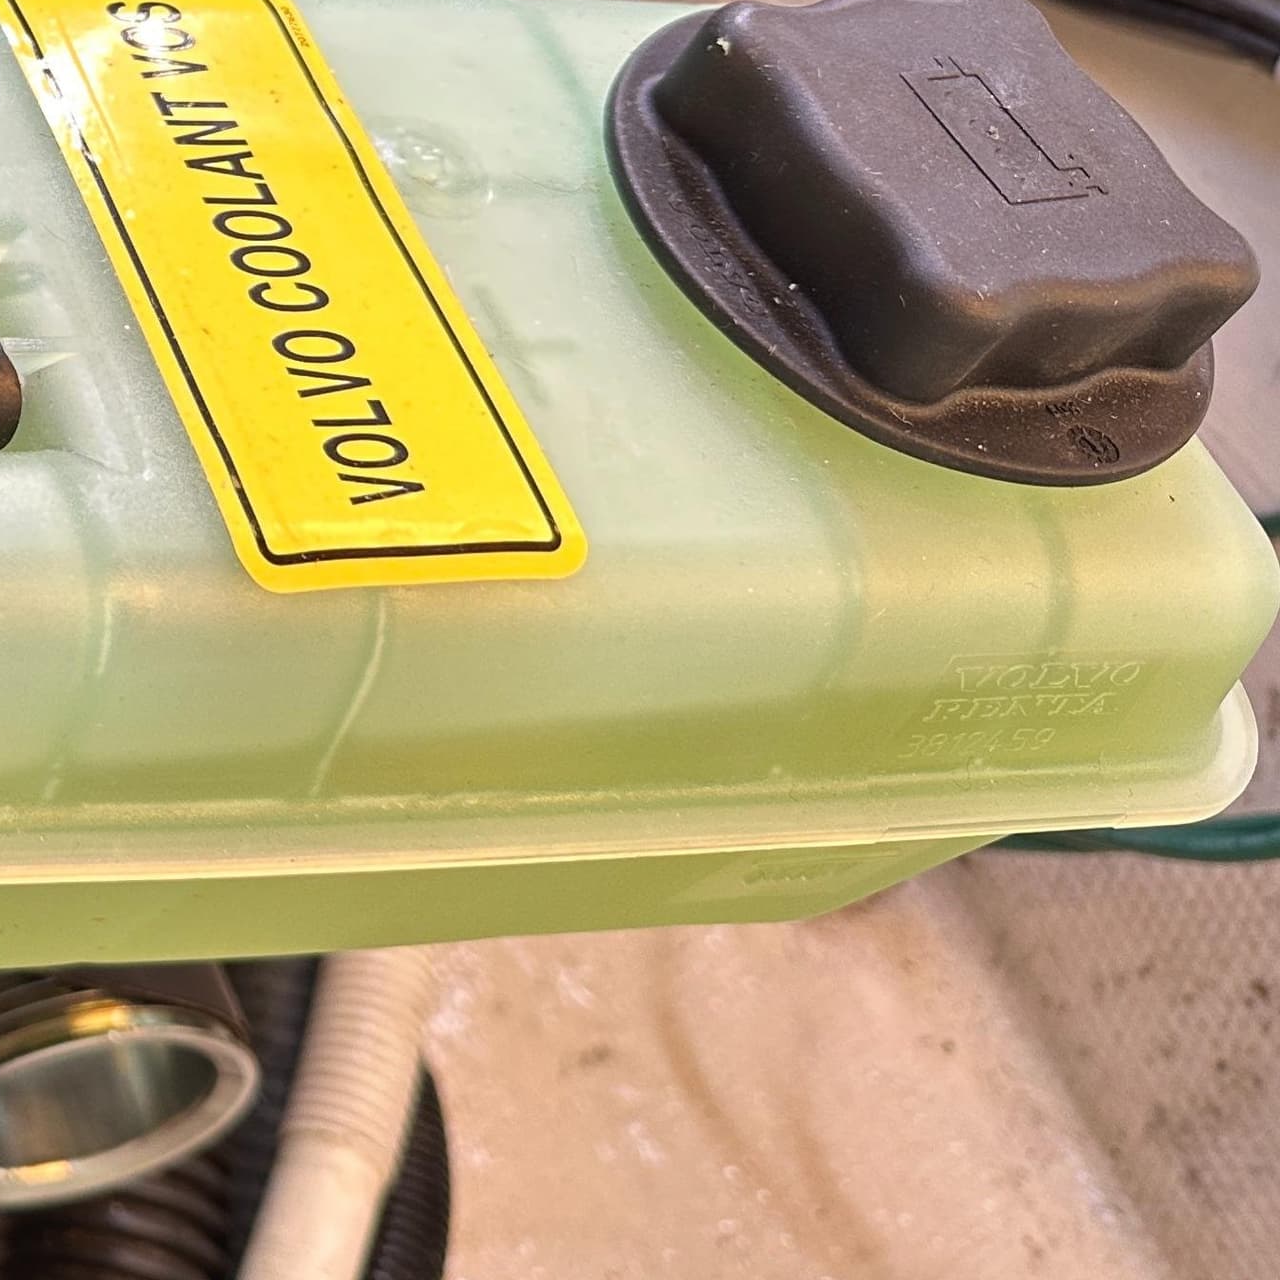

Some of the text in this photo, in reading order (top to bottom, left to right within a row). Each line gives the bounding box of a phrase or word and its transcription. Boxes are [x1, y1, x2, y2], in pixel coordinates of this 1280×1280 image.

[107, 0, 427, 506] VOLVO COOLANT VCS
[955, 662, 1144, 693] VOLVO
[922, 692, 1118, 723] PENTA
